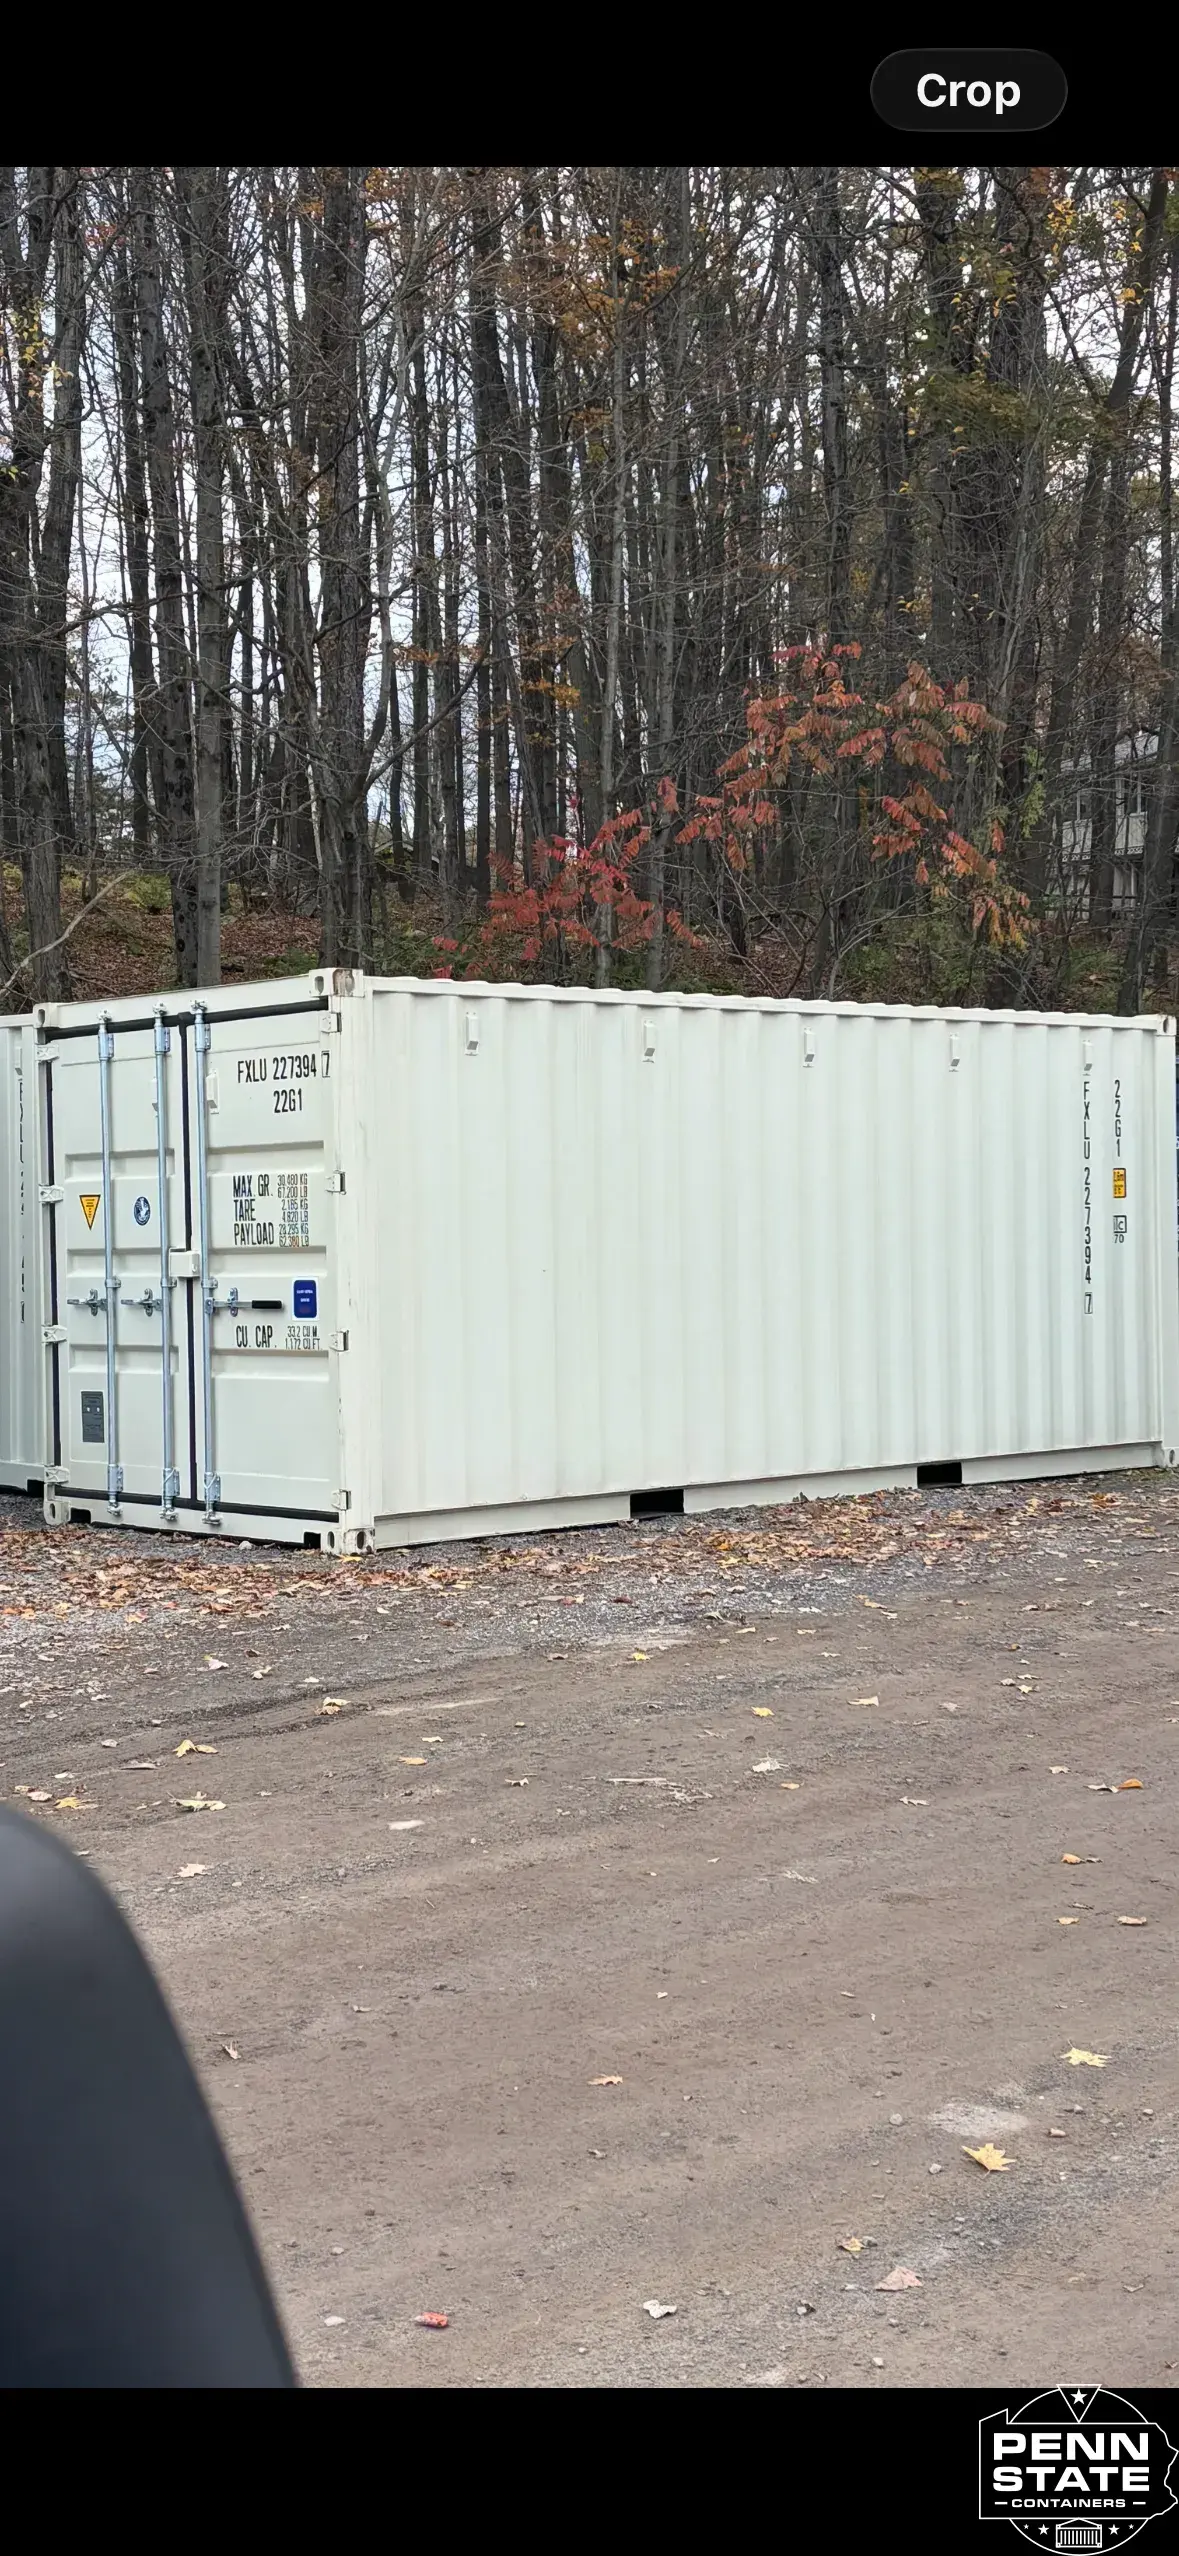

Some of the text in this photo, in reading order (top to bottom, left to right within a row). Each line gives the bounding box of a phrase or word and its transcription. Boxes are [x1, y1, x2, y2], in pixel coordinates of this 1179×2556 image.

[238, 1051, 330, 1083] FXLU 227394 7
[273, 1088, 302, 1113] 22G1
[258, 1174, 273, 1197] GR.
[300, 1173, 308, 1185] KG
[278, 1186, 308, 1198] 67.200 LB
[233, 1199, 256, 1222] TARE
[300, 1199, 308, 1211] KG
[300, 1211, 308, 1222] LB
[1084, 1166, 1092, 1284] 227394
[234, 1222, 274, 1245] PAYLOAD
[300, 1223, 309, 1235] KG
[1114, 1234, 1124, 1244] 70
[301, 1235, 309, 1247] LB
[1084, 1292, 1093, 1313] 7
[236, 1325, 277, 1348] CU. CAP.
